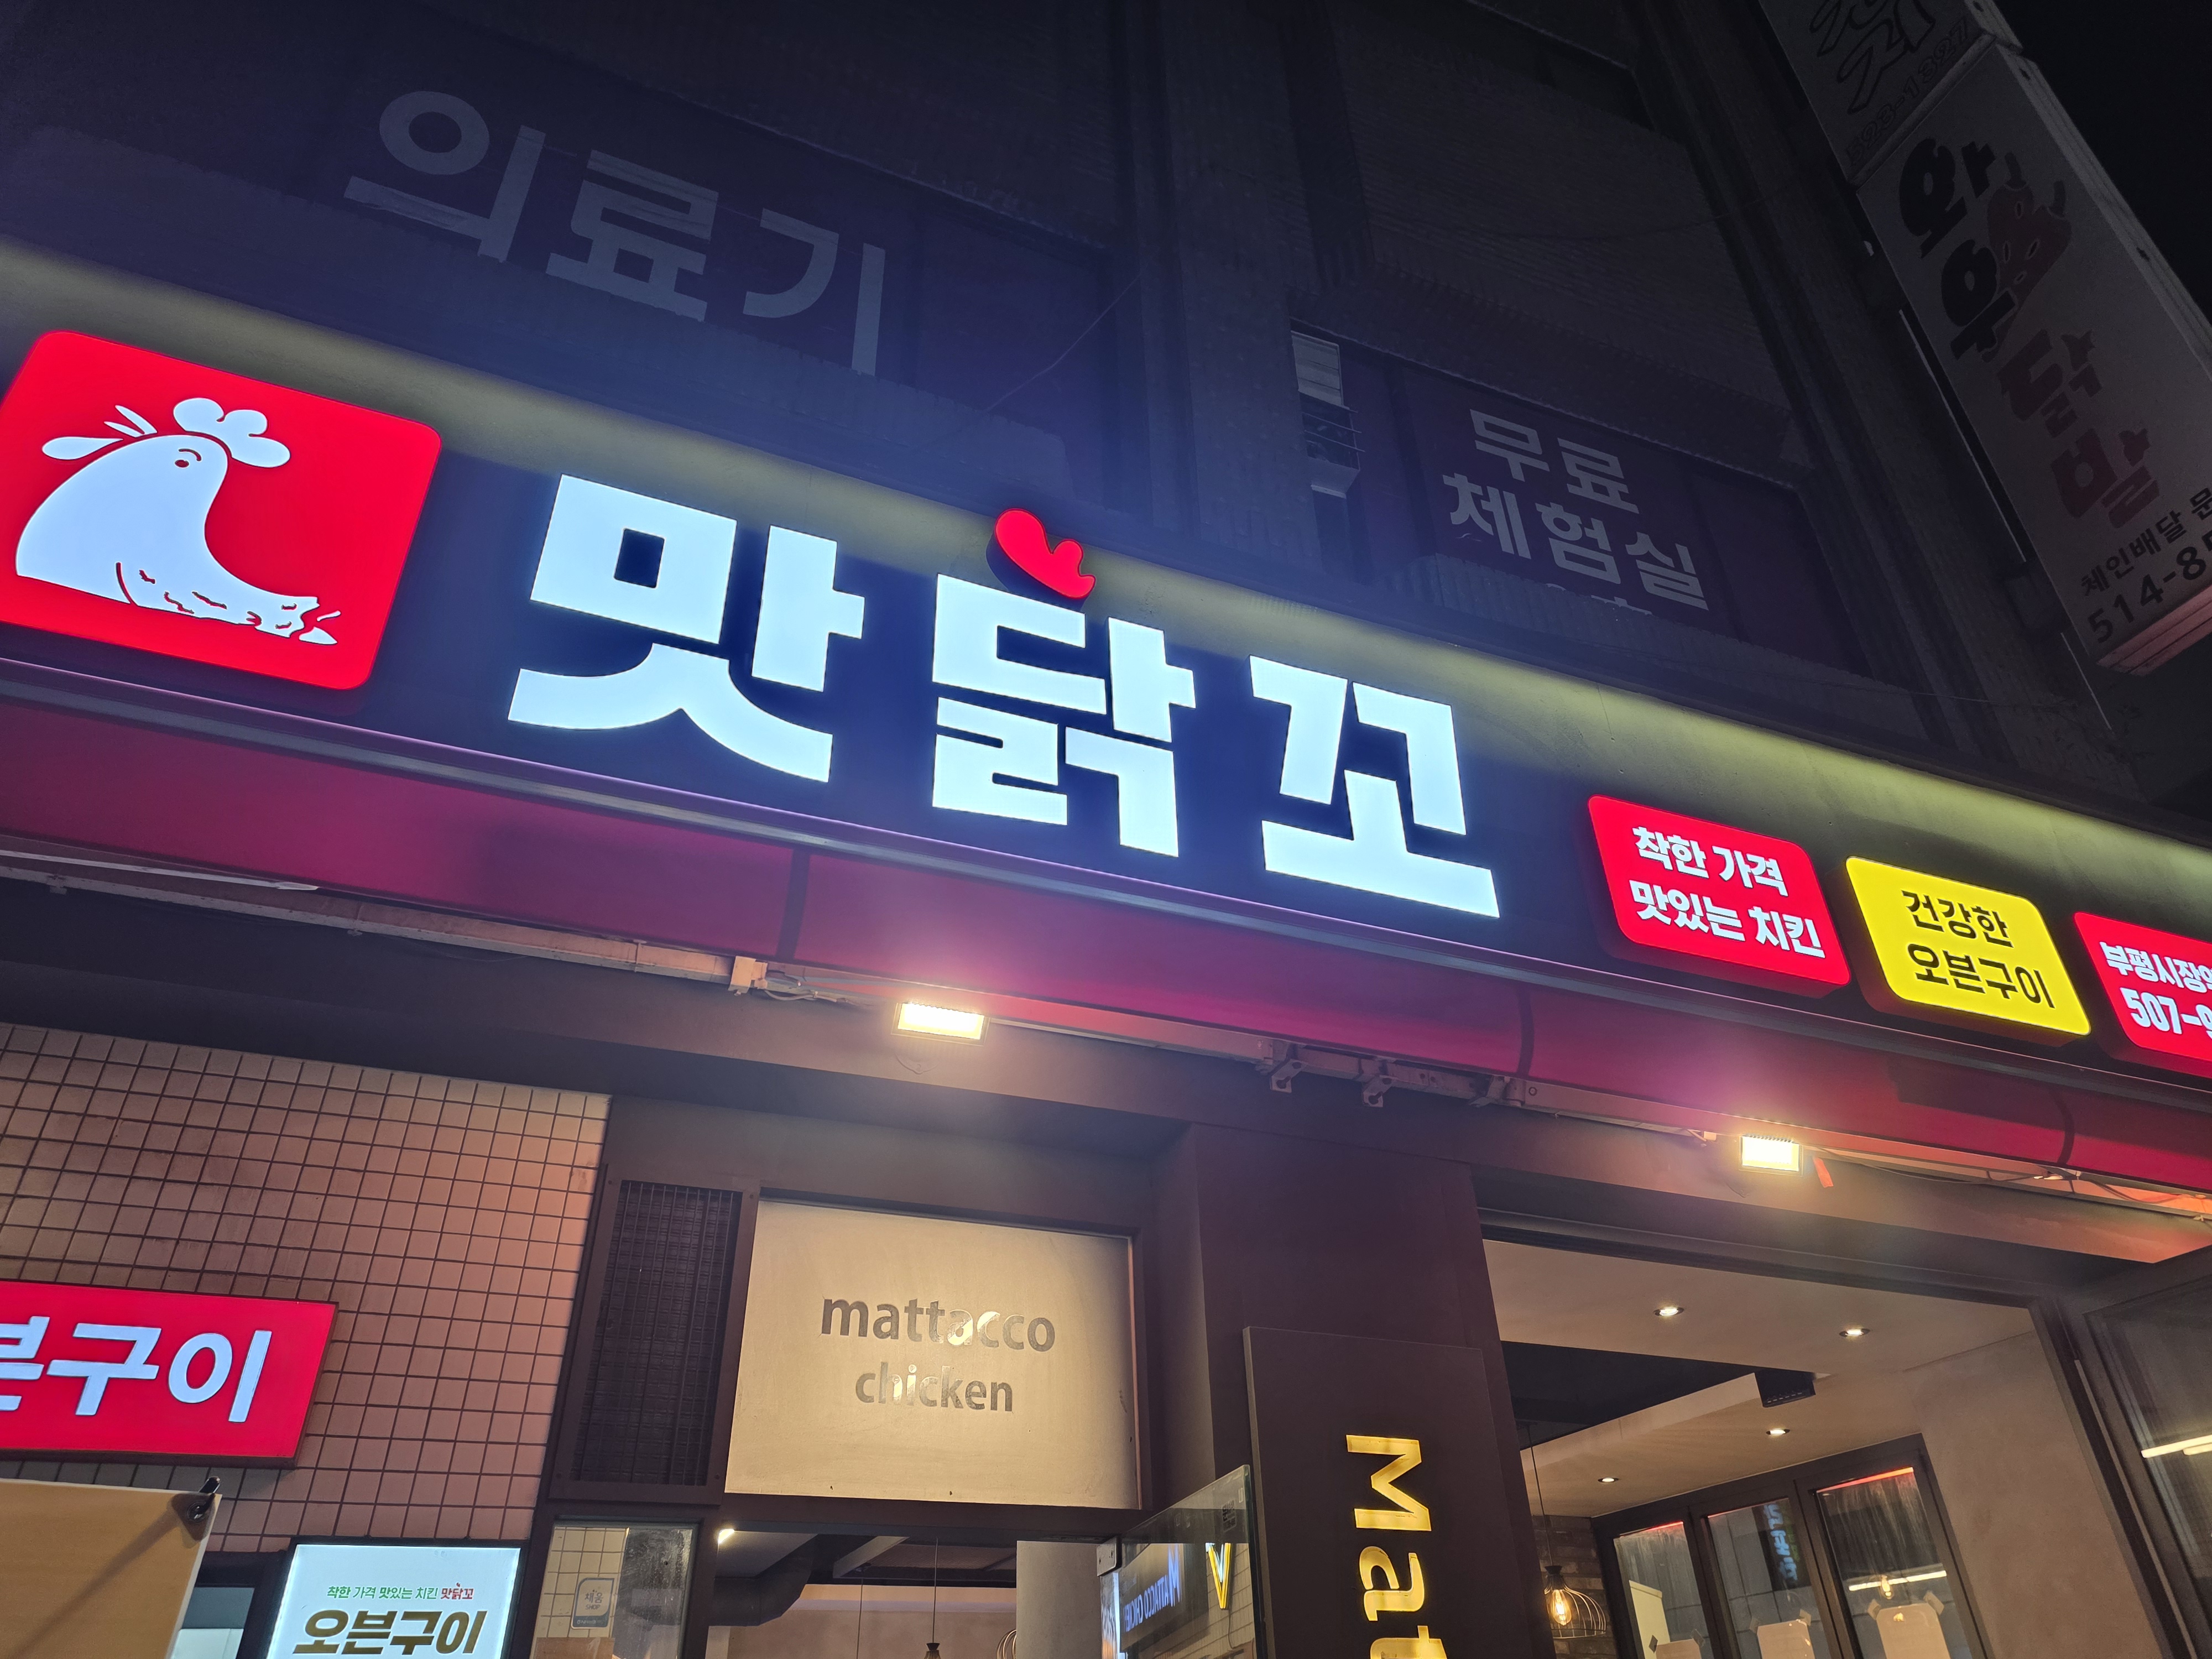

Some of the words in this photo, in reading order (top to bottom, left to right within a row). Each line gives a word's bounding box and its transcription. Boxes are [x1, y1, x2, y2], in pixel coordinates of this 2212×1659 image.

[1844, 16, 1970, 166] 523-1327
[1469, 408, 1640, 514] 무료
[1442, 472, 1709, 611] 체험실
[2081, 510, 2187, 597] 체인배달
[508, 474, 1500, 918] 맛닭꼬
[1632, 826, 1709, 879] 착한
[1712, 845, 1788, 897] 가격
[1629, 879, 1746, 942] 맛있는
[1747, 906, 1825, 958] 치킨
[1900, 889, 2015, 948] 건강한
[1907, 943, 2056, 1009] 오븐구이
[821, 1298, 1056, 1352] mattacco
[855, 1361, 1013, 1412] chicken
[327, 1586, 351, 1599] 착한
[352, 1586, 377, 1599] 가격
[378, 1587, 413, 1599] 맛있는
[414, 1587, 439, 1600] 치킨
[440, 1587, 474, 1600] 맛닭꼬
[585, 1590, 604, 1603] 채움
[292, 1609, 488, 1655] 오븐구이
